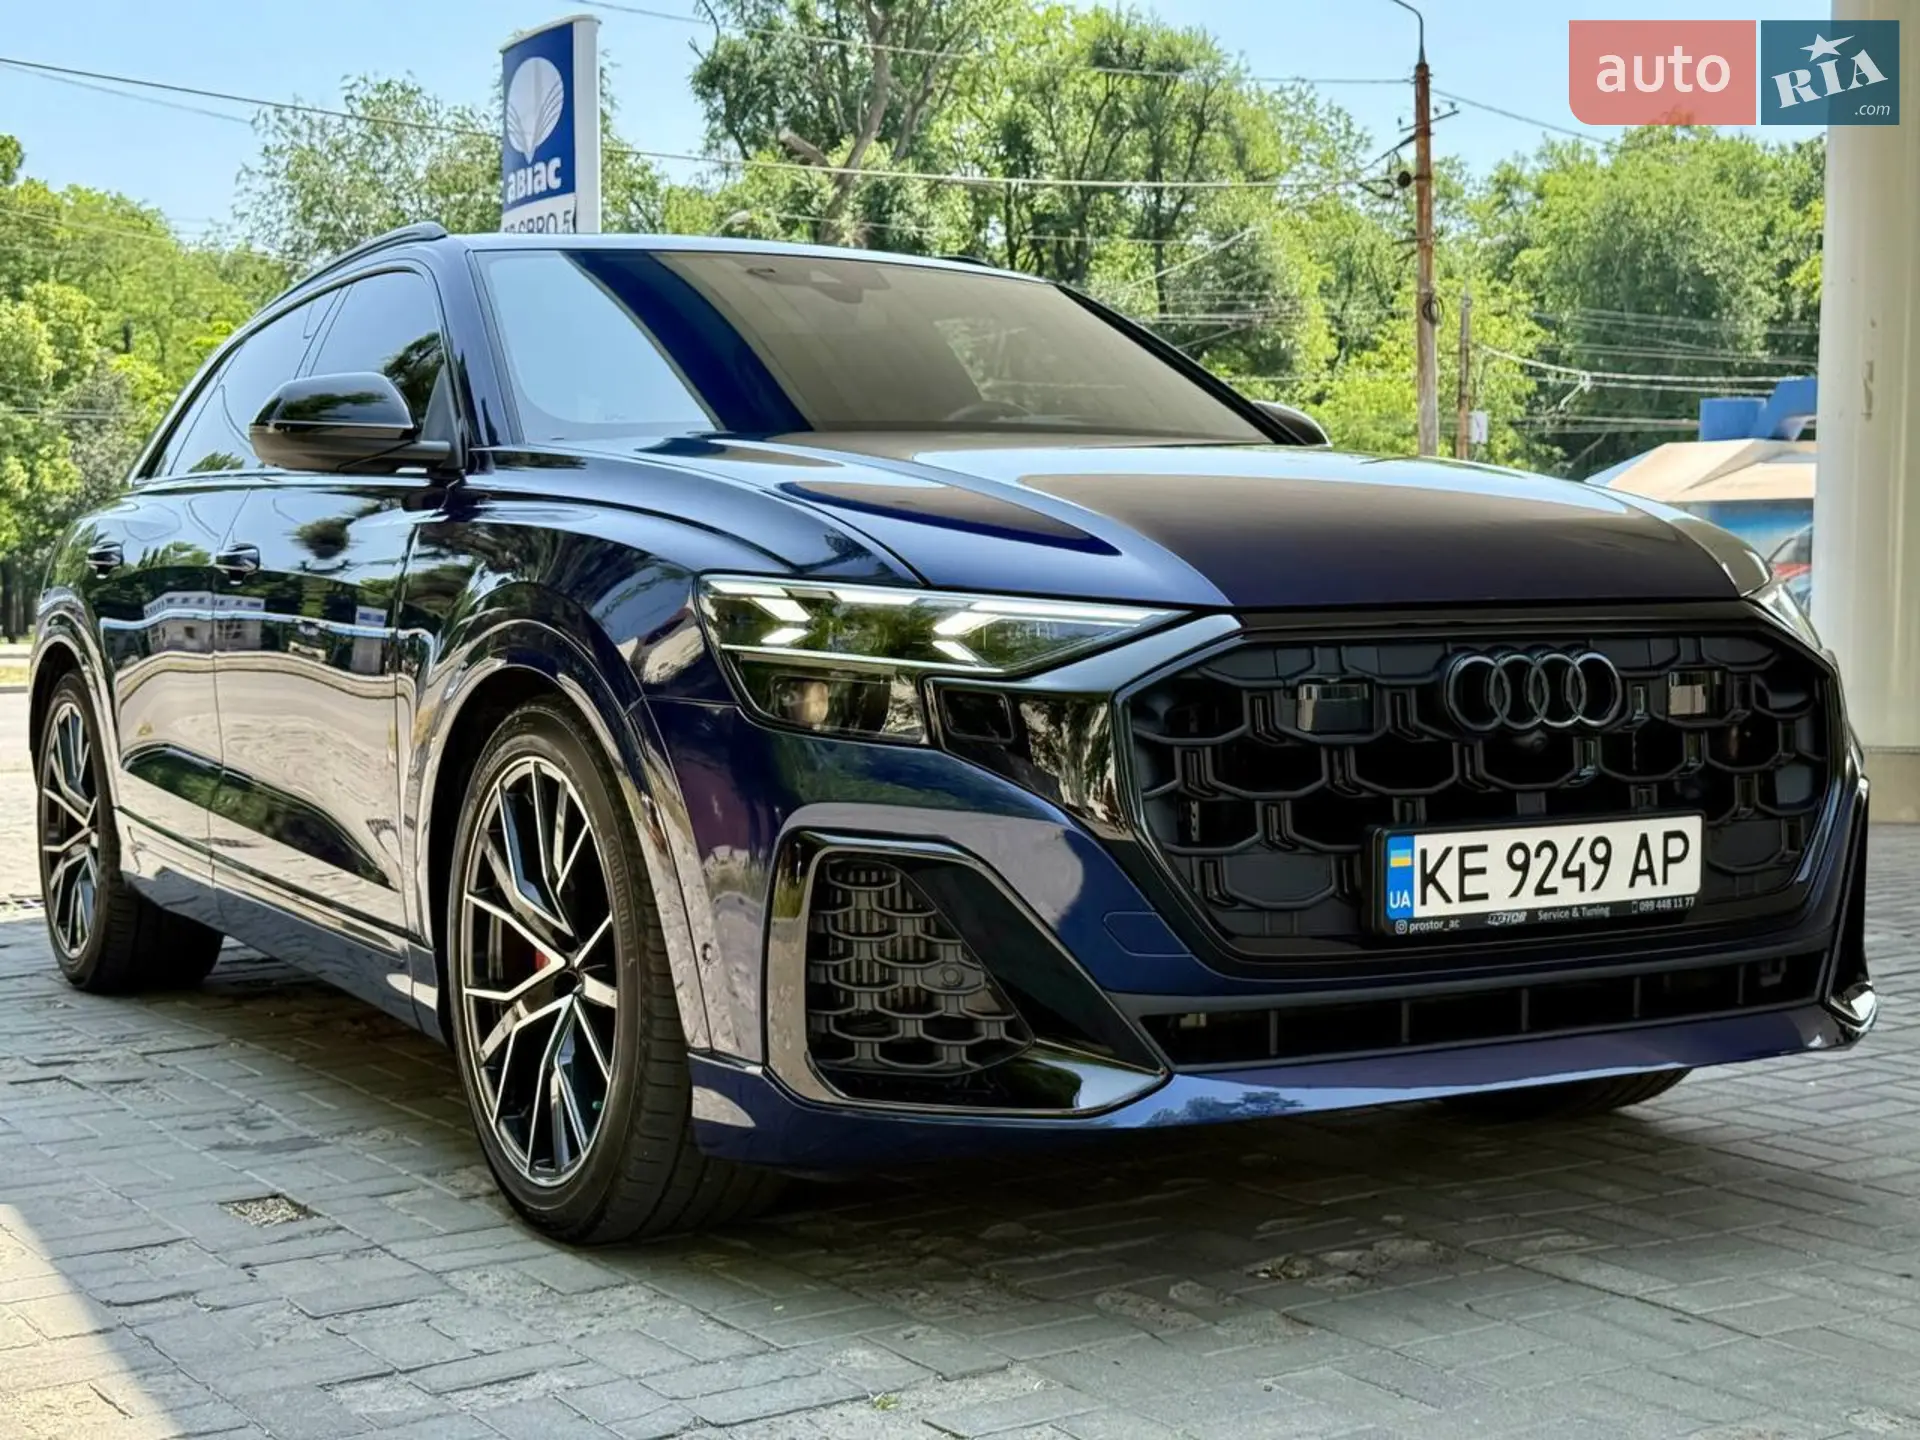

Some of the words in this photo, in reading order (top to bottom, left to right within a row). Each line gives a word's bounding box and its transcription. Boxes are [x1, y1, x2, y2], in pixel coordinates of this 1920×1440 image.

[1419, 844, 1489, 906] KE
[1505, 836, 1613, 898] 9249
[1628, 829, 1690, 888] AP
[1389, 890, 1412, 909] UA
[1537, 908, 1570, 921] Service
[1572, 906, 1580, 918] &
[1582, 904, 1611, 918] Tuning
[1409, 919, 1460, 934] prostor_ac
